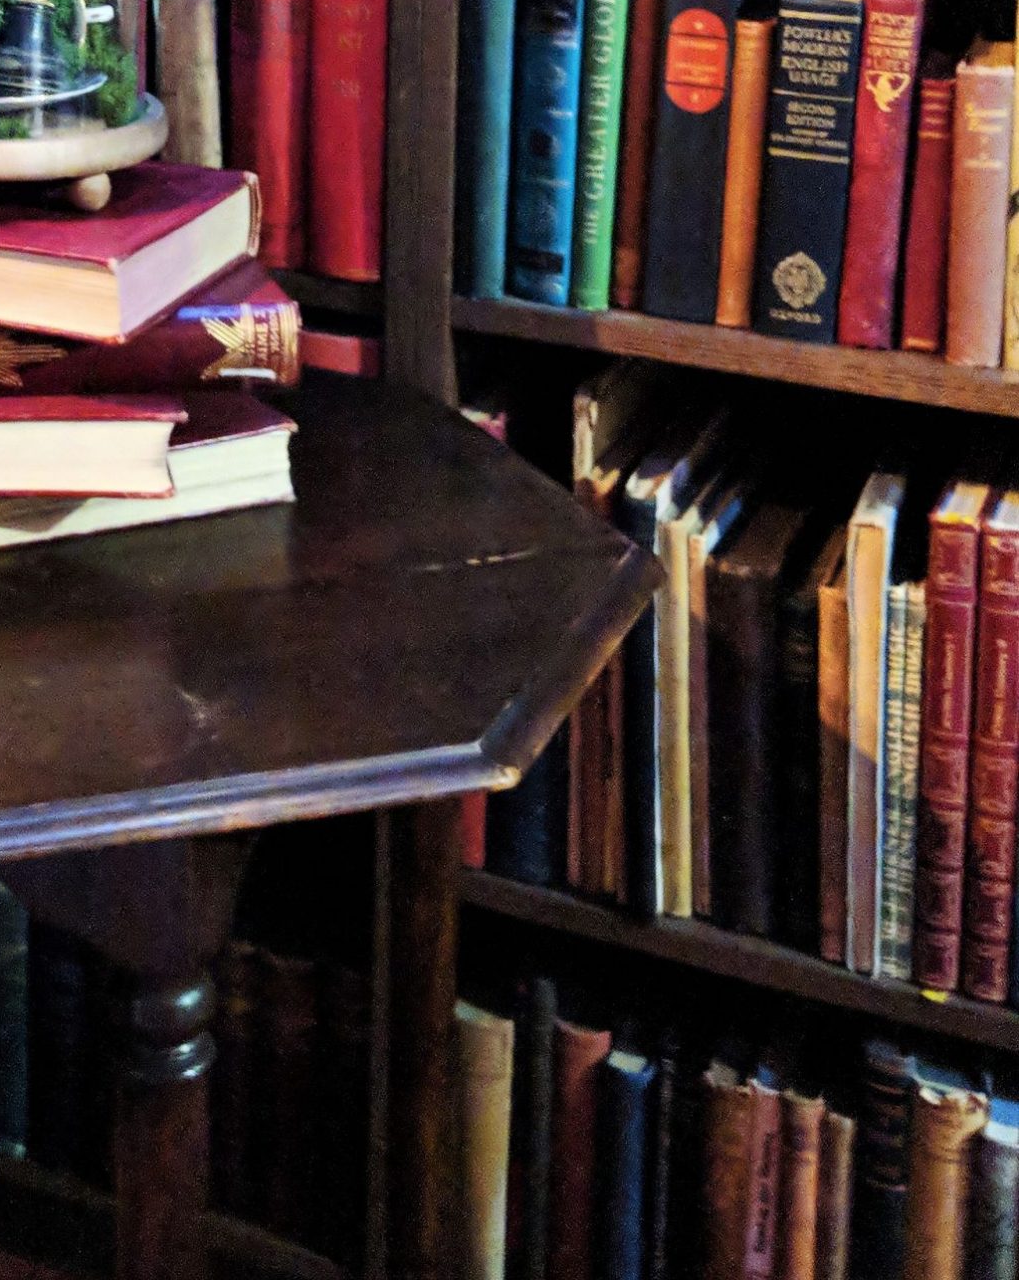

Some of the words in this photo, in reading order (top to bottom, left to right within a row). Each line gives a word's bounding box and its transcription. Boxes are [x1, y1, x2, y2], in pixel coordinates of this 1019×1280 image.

[783, 24, 853, 44] FOWLER'S
[782, 39, 849, 57] MODERN
[781, 55, 849, 73] ENGLISH
[788, 70, 839, 88] USAGE
[788, 101, 837, 116] SECOND
[785, 114, 836, 129] EDITION
[584, 74, 611, 201] GREATER
